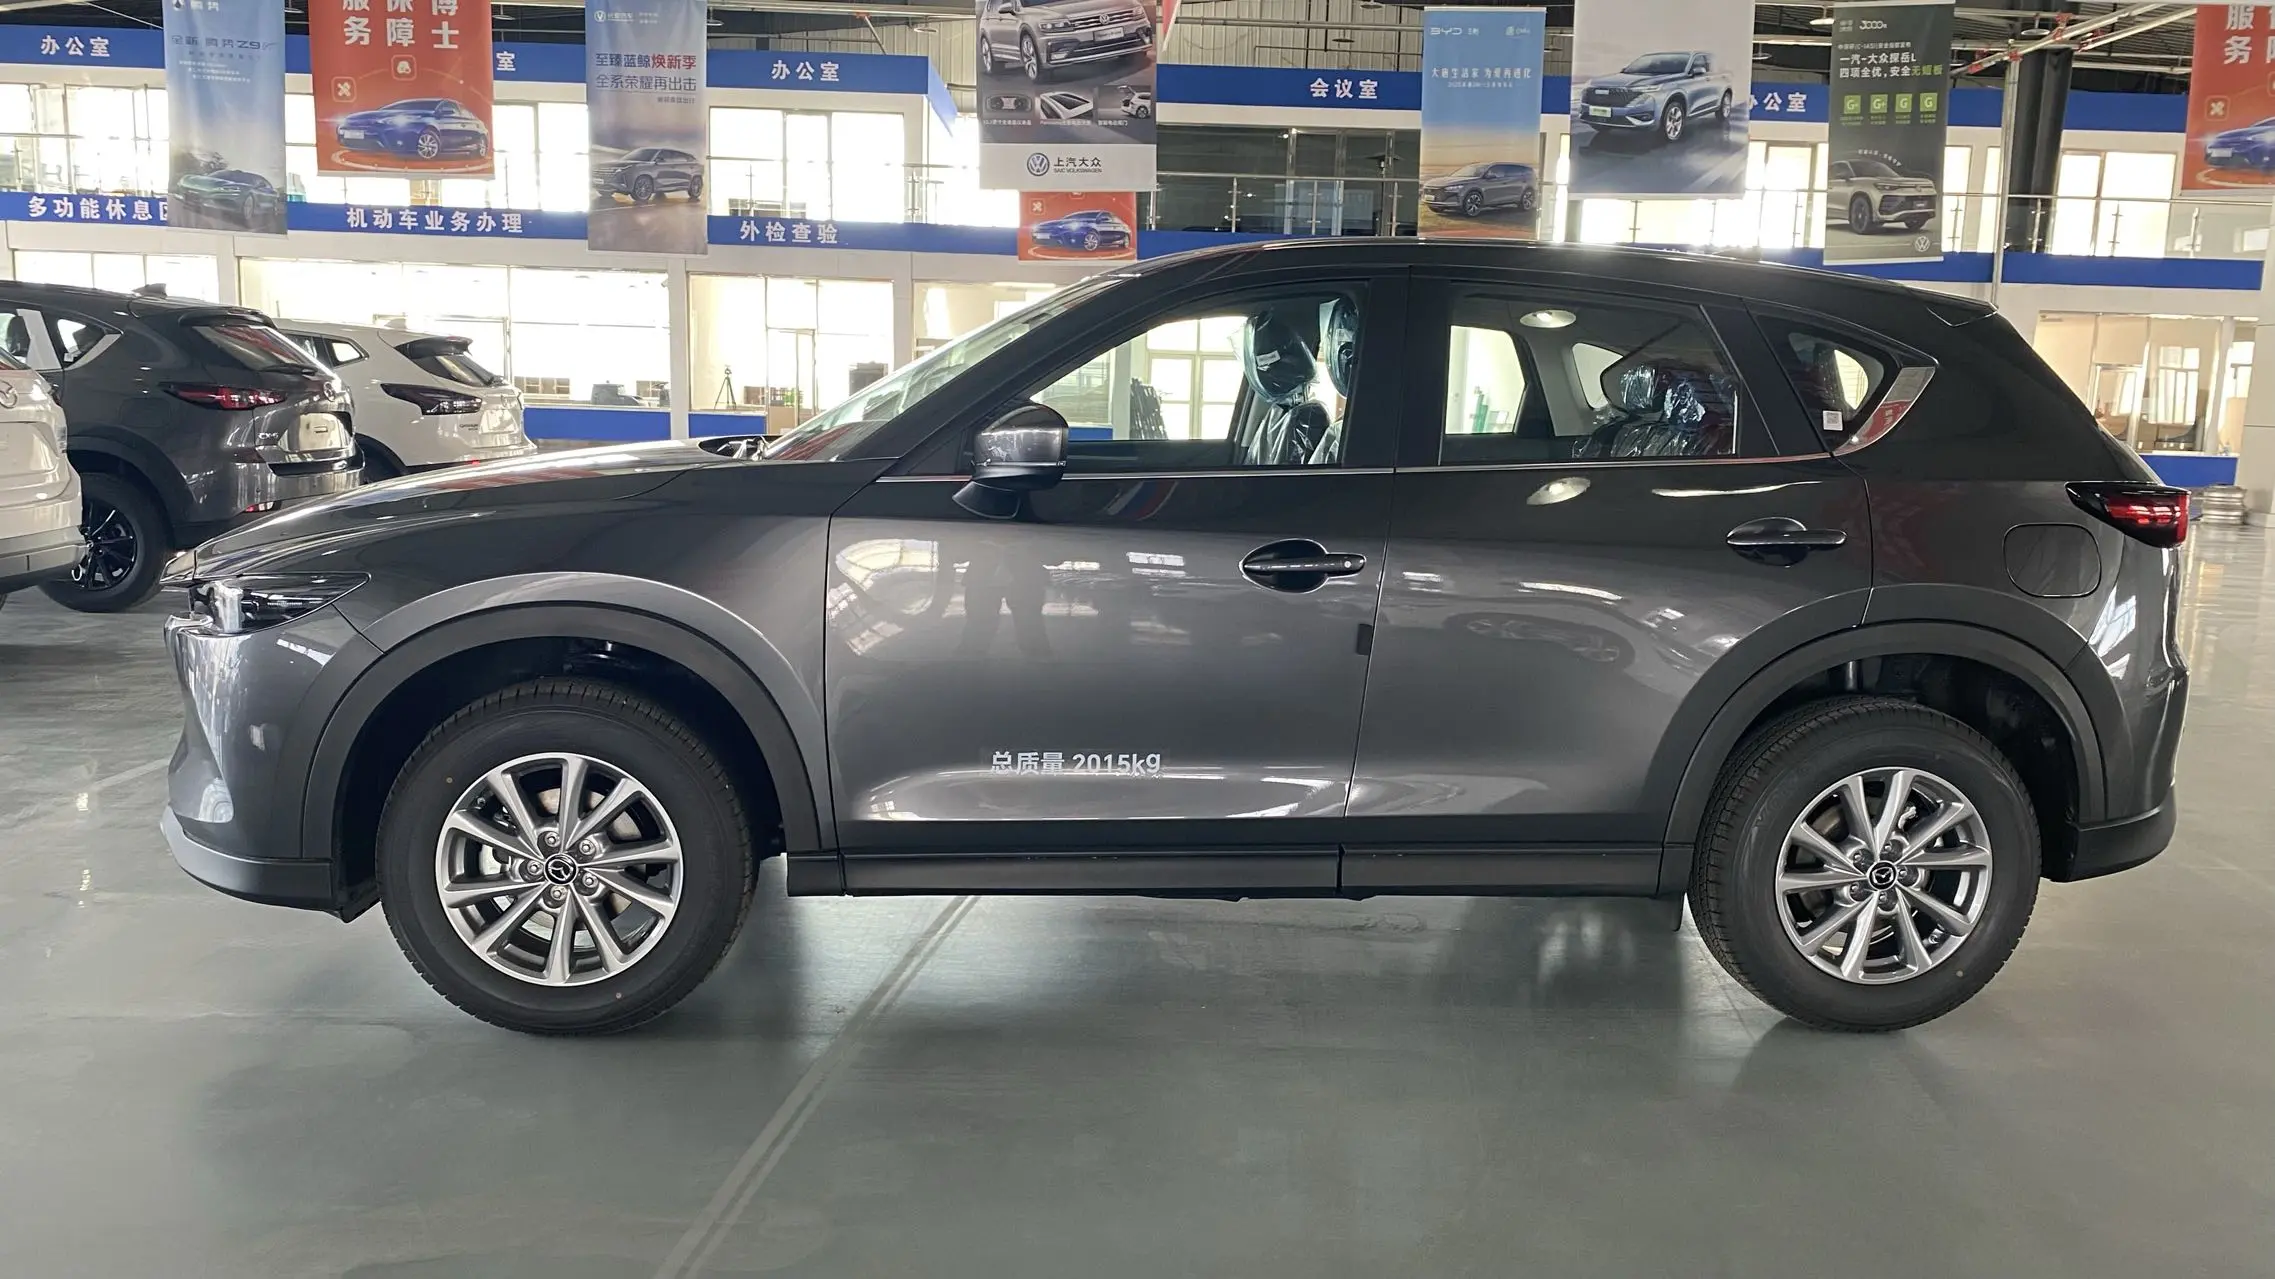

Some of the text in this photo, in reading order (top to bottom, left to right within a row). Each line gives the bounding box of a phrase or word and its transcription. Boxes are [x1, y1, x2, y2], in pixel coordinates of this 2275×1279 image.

[1430, 27, 1462, 35] BYD
[40, 34, 110, 57] 办公室
[496, 51, 516, 72] 室
[595, 53, 697, 70] 至臻蓝鲸焕新季
[771, 60, 839, 82] 办公室
[595, 74, 697, 92] 全系荣耀再出击
[1310, 77, 1378, 99] 会议室
[1900, 98, 1908, 109] G
[1924, 97, 1933, 108] G
[1053, 156, 1102, 168] 上汽大众
[347, 207, 523, 233] 机动车业务办理
[740, 220, 838, 244] 外检查验
[991, 751, 1161, 777] 总质量 2015kg
